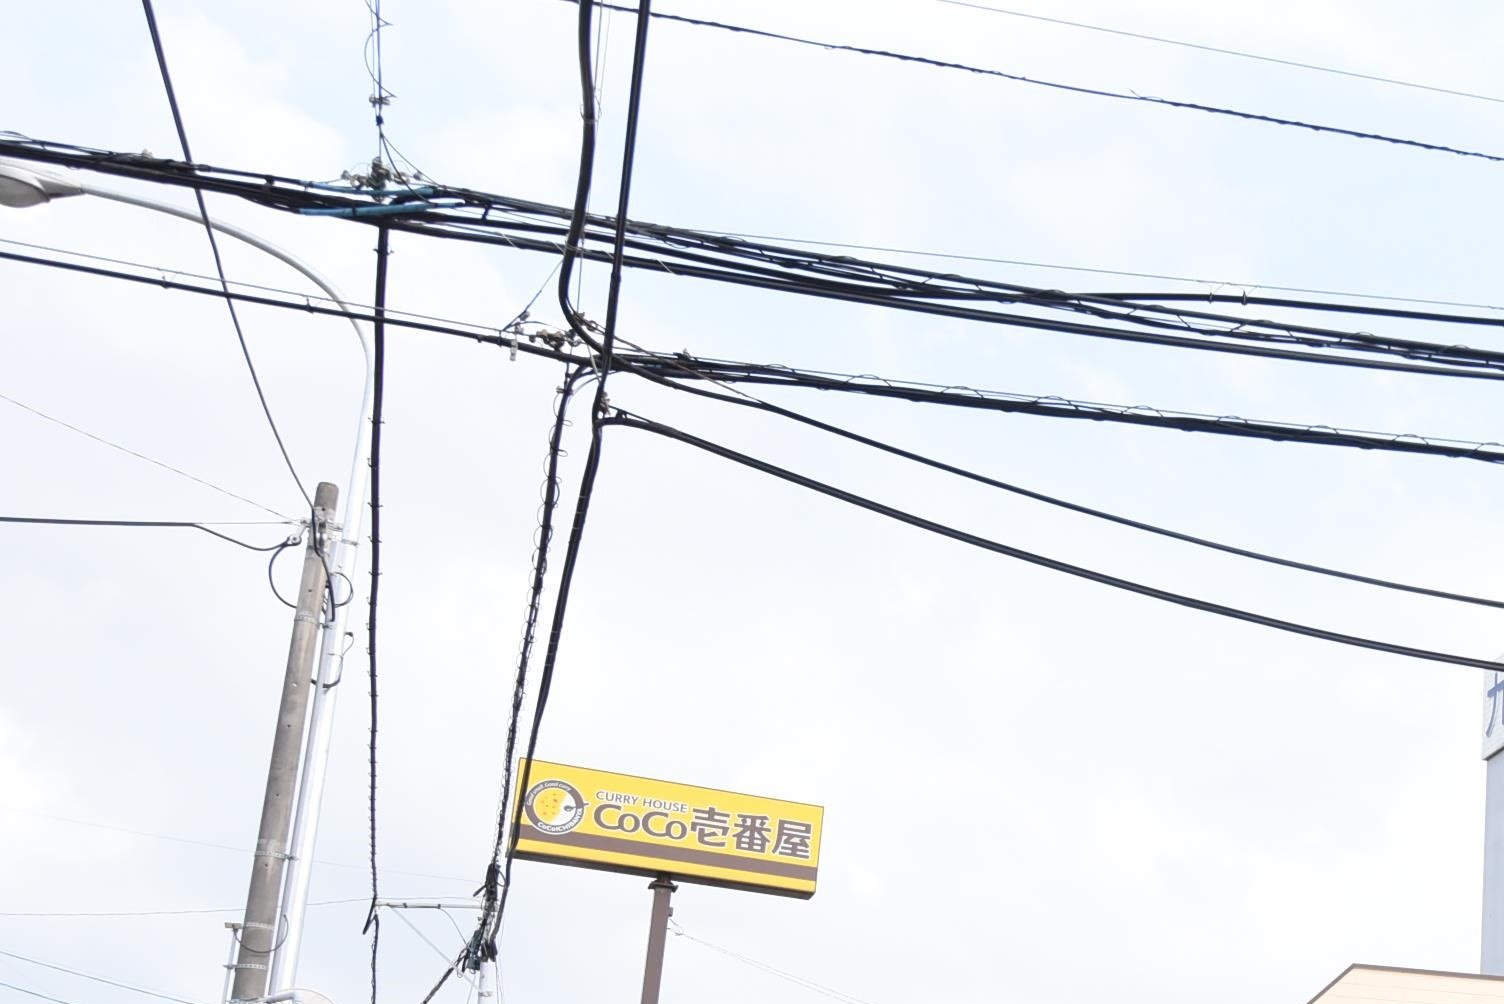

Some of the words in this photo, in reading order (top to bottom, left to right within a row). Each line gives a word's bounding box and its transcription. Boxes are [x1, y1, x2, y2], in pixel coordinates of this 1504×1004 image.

[595, 791, 639, 805] CURRY
[643, 798, 688, 813] HOUSE
[593, 803, 812, 860] CoCo壱番屋
